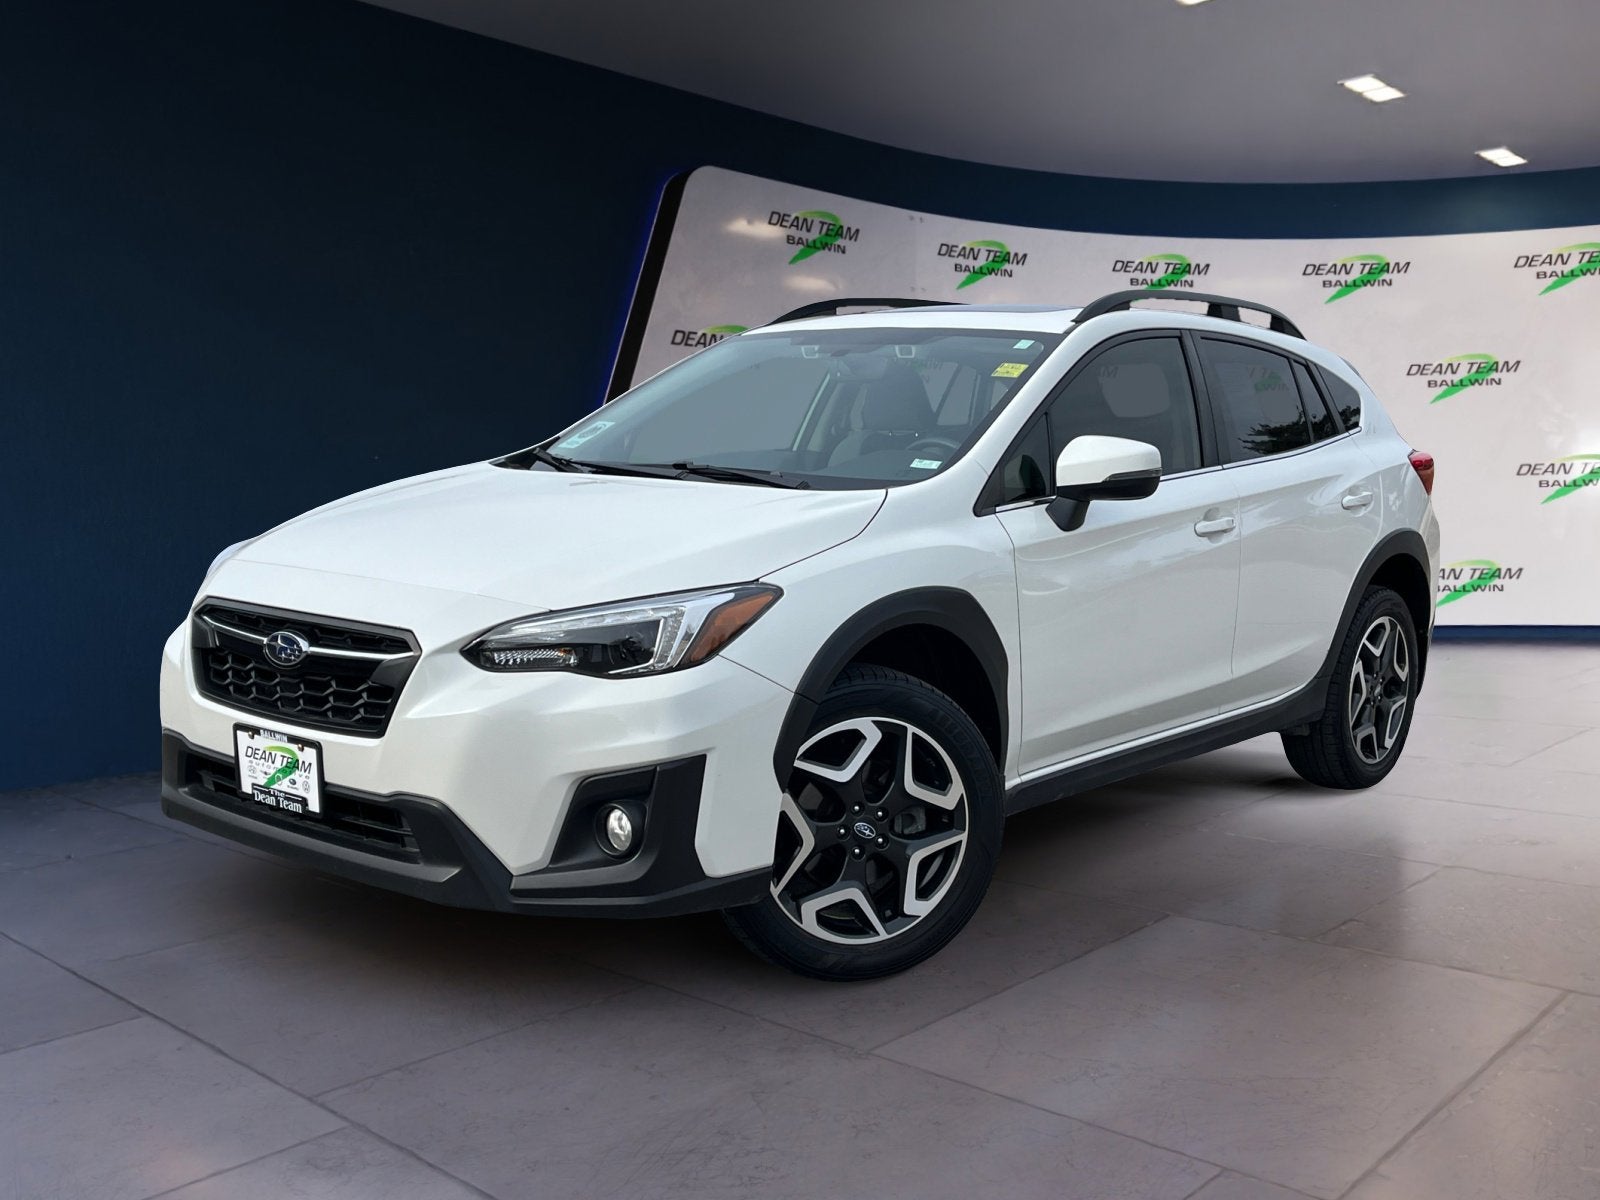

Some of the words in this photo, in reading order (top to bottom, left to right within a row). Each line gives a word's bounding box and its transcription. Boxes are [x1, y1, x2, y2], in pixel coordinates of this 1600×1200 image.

[768, 211, 815, 234] DEAN
[818, 220, 860, 243] TEAM
[786, 234, 847, 255] BALLWIN
[937, 243, 983, 263] DEAN
[984, 248, 1028, 267] TEAM
[1514, 253, 1571, 268] DEAN
[1578, 251, 1600, 264] TE
[954, 263, 1013, 278] BALLWIN
[1112, 259, 1160, 275] DEAN
[1163, 261, 1210, 276] TEAM
[1302, 263, 1352, 277] DEAN
[1356, 261, 1411, 276] TEAM
[1536, 267, 1600, 279] BALLW
[1129, 277, 1194, 288] BALLWIN
[1322, 277, 1393, 289] BALLWIN
[1406, 361, 1461, 376] DEAN
[1466, 360, 1521, 374] TEAM
[1427, 377, 1502, 388] BALLWIN
[1516, 462, 1574, 476] DEAN
[1538, 479, 1600, 488] BALLW
[1438, 567, 1464, 580] AN
[1469, 567, 1524, 580] TEAM
[1437, 583, 1504, 593] ALLWIN
[245, 745, 277, 765] DEAN
[280, 754, 312, 775] TEAM
[253, 789, 276, 806] Dean
[277, 796, 302, 813] Team
[268, 789, 286, 798] The
